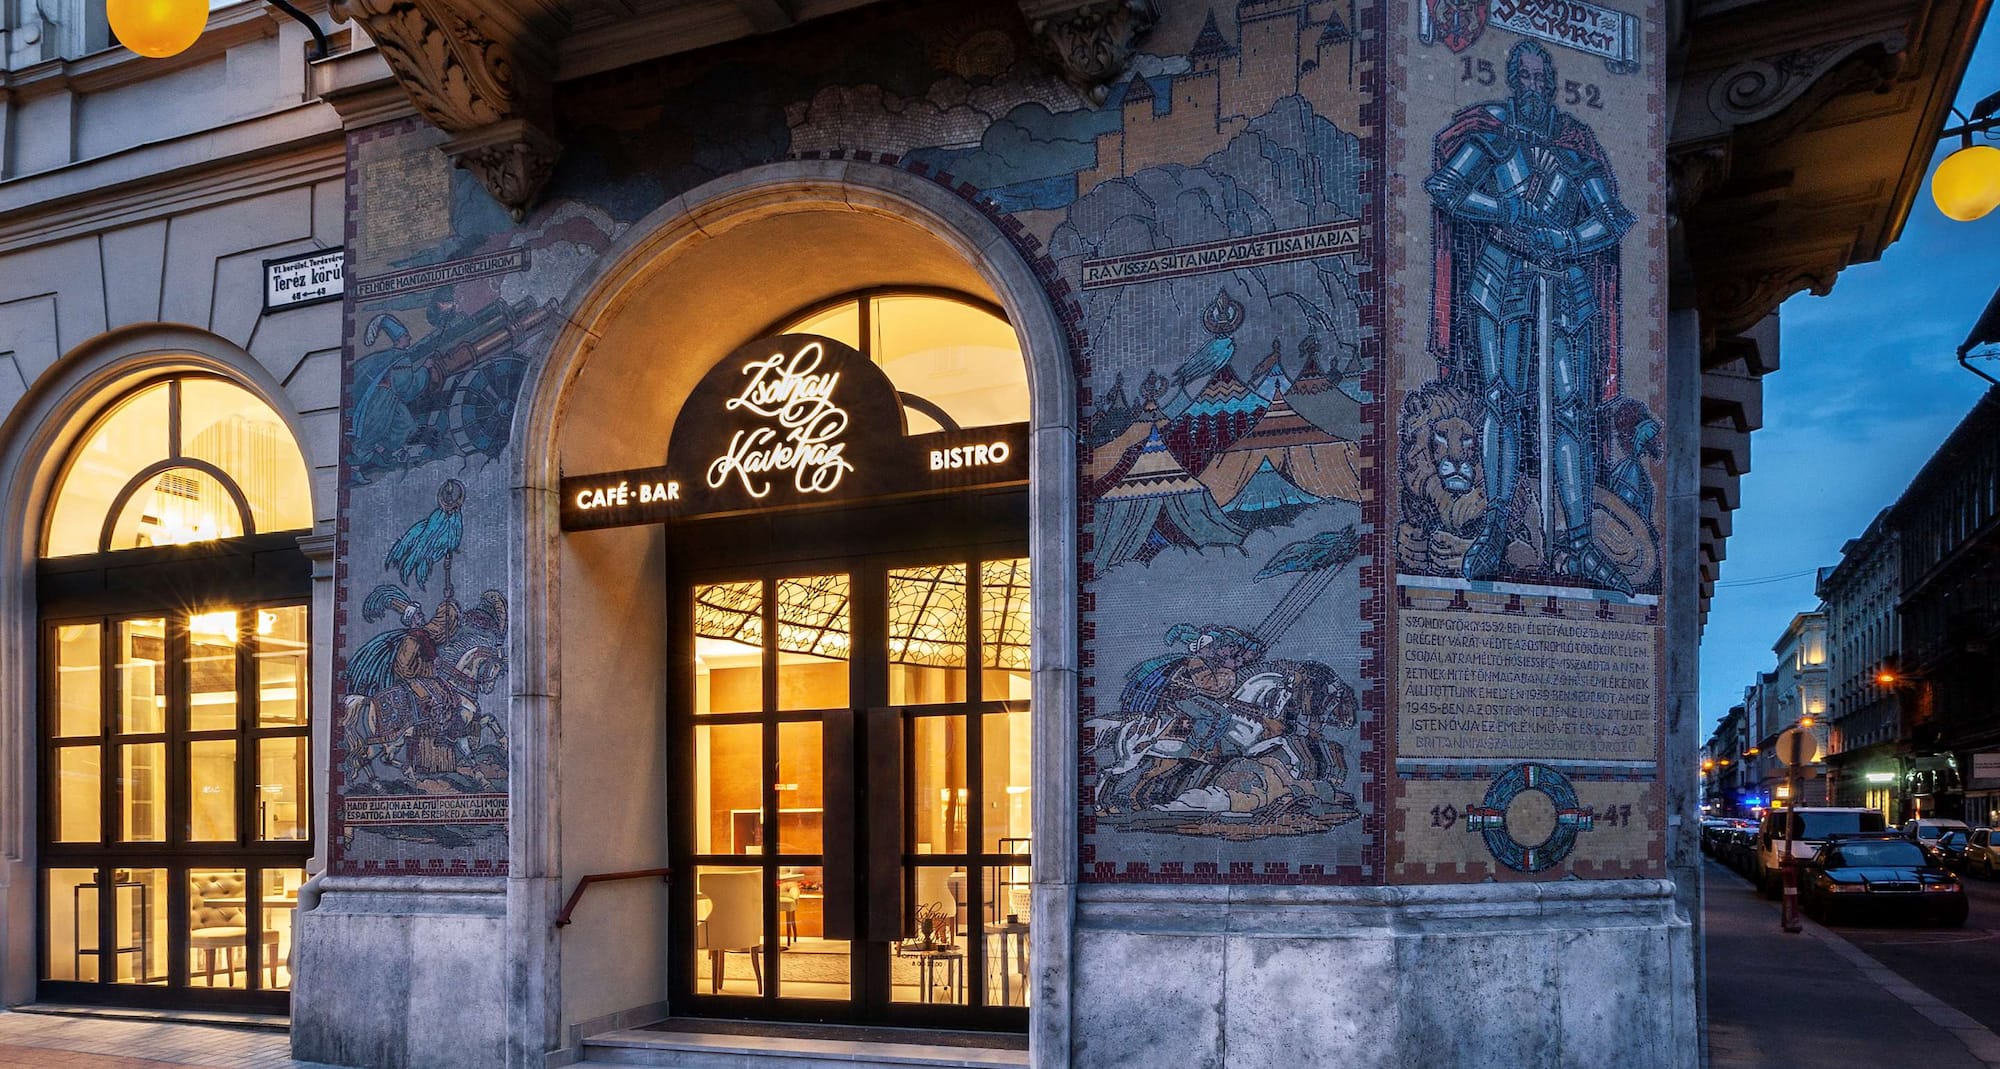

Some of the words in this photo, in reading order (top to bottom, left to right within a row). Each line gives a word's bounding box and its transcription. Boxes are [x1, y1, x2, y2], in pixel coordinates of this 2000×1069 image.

[1460, 54, 1496, 87] 15
[1564, 80, 1604, 109] 52
[273, 272, 306, 292] Teréz
[725, 342, 841, 427] Zsolnay
[930, 442, 1010, 471] BISTRO
[576, 481, 628, 510] CAFÉ
[639, 482, 680, 502] BAR
[1411, 719, 1448, 731] ISTEN
